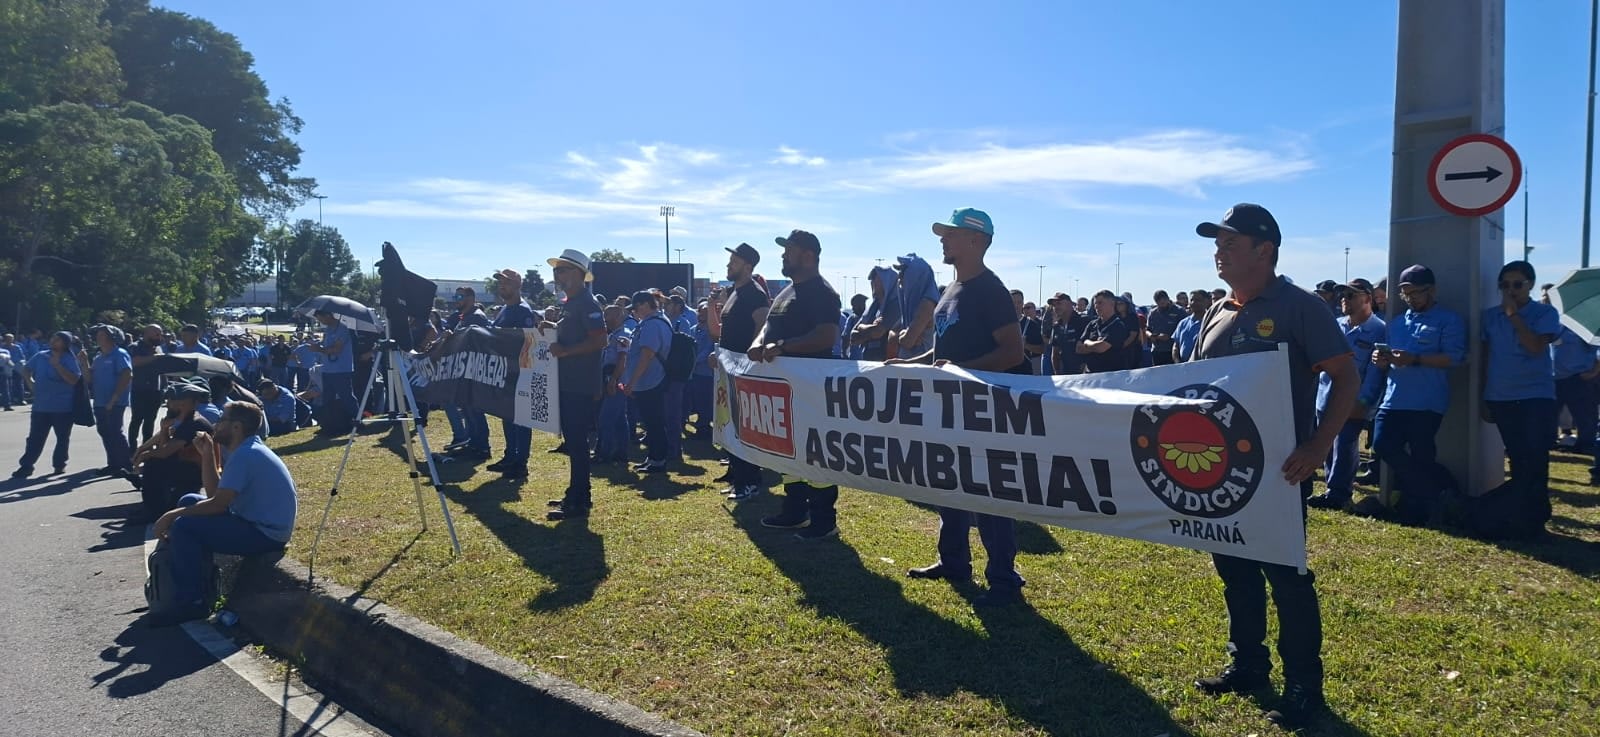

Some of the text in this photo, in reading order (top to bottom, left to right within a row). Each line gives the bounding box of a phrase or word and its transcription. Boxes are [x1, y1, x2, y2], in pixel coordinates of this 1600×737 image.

[739, 390, 788, 439] PARE
[825, 376, 1046, 436] HOJE TEM
[806, 427, 1118, 515] ASSEMBLEIA!
[1140, 457, 1255, 513] SINDICAL
[1168, 519, 1247, 546] PARANÁ
